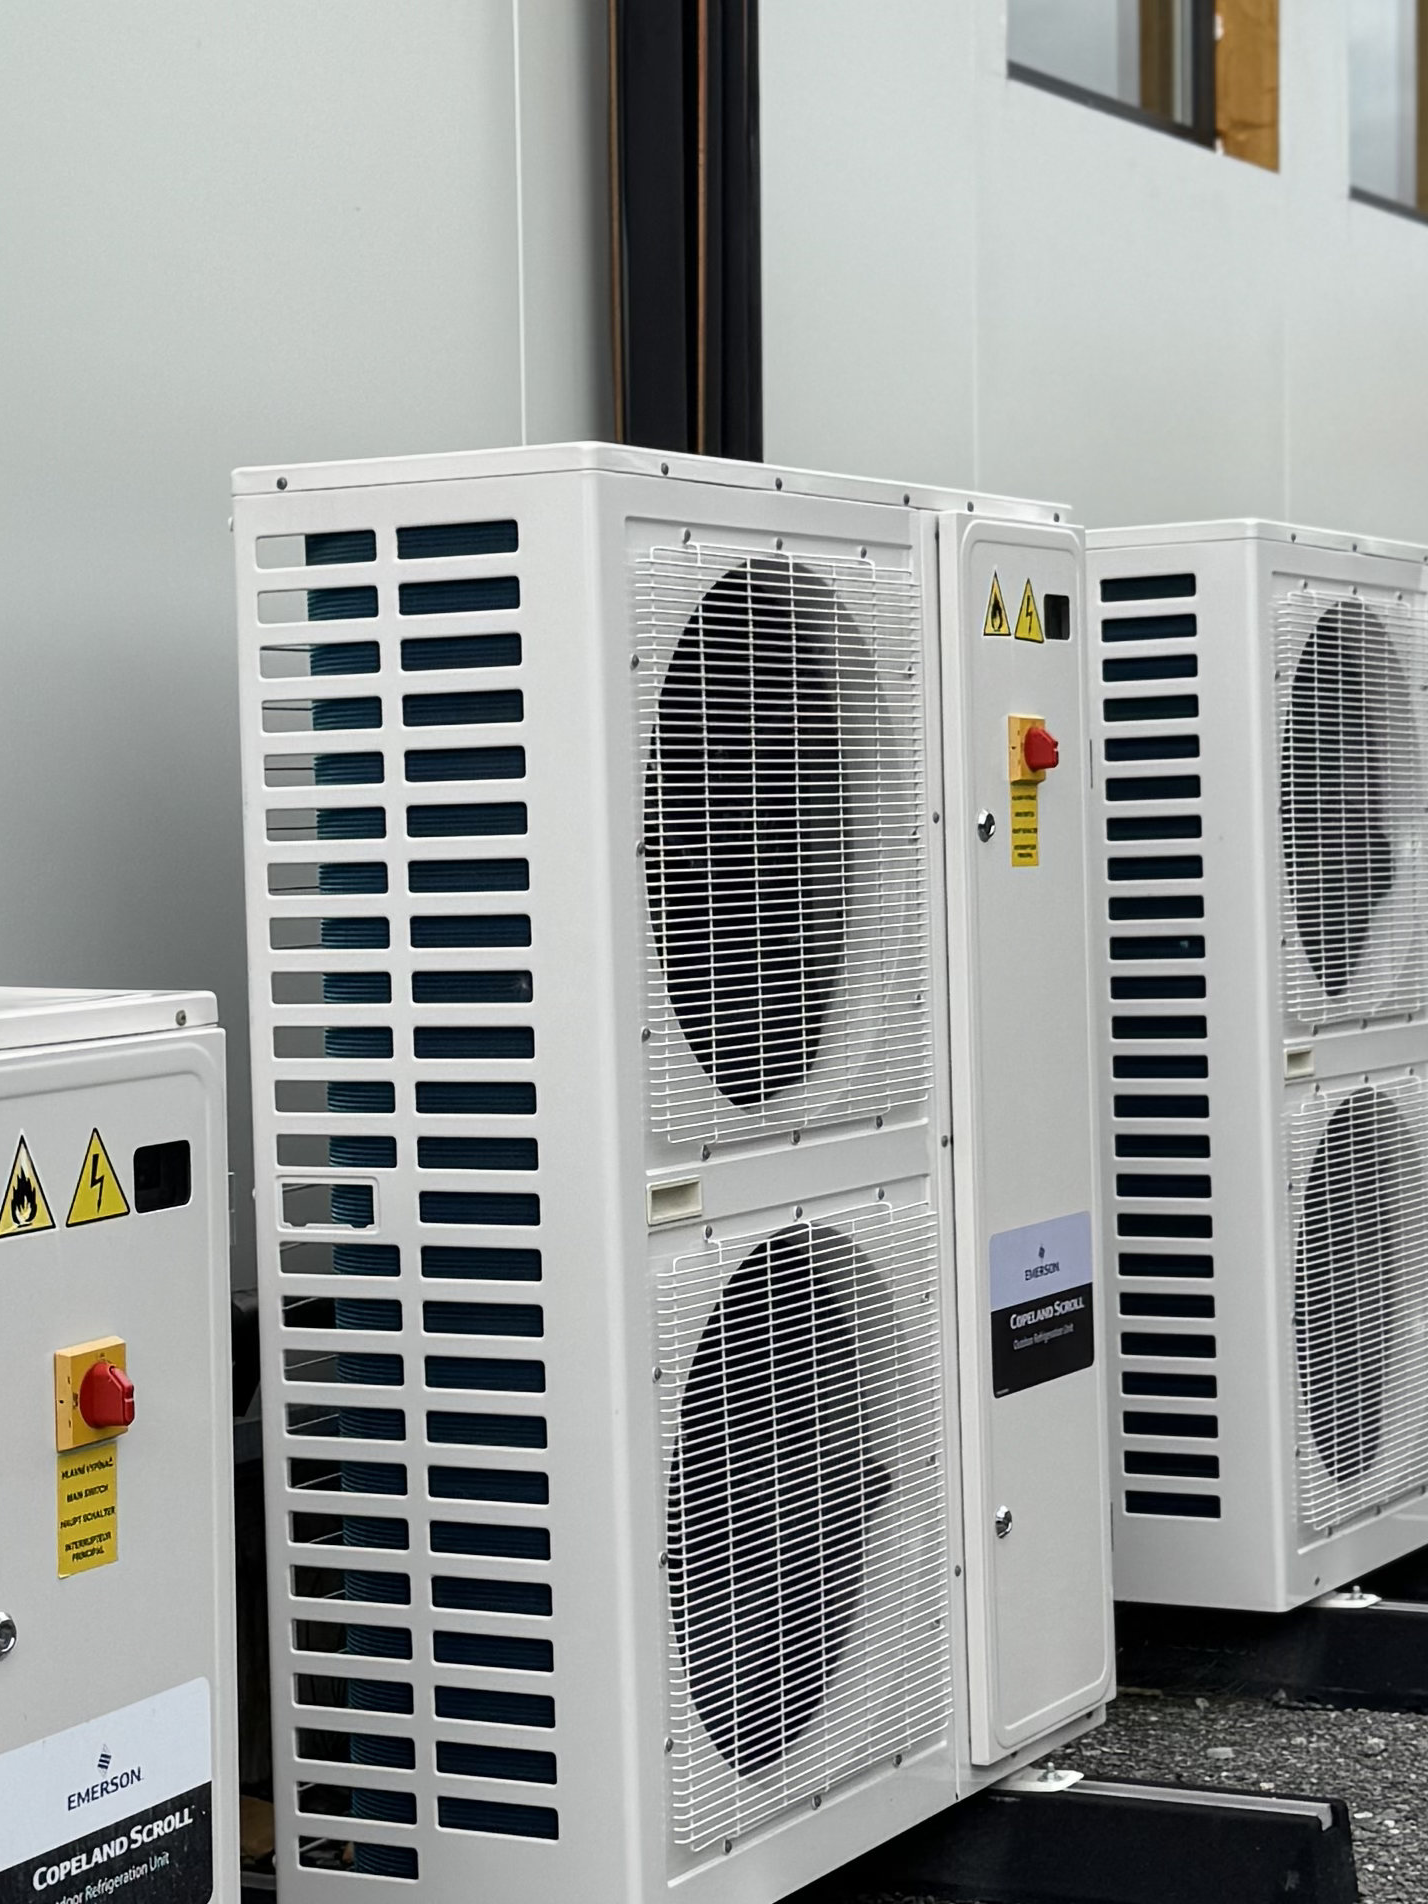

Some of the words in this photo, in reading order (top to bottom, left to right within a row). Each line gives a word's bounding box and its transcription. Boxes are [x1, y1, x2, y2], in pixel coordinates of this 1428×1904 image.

[1025, 1261, 1060, 1281] EMERSON
[1010, 1305, 1053, 1330] COPELAND
[1053, 1296, 1085, 1316] SCROLL
[67, 1766, 142, 1811] EMERSON
[32, 1836, 128, 1891] COPELAND
[129, 1807, 193, 1849] SCROLL
[84, 1862, 148, 1902] Refrigeration
[149, 1851, 170, 1872] Unit
